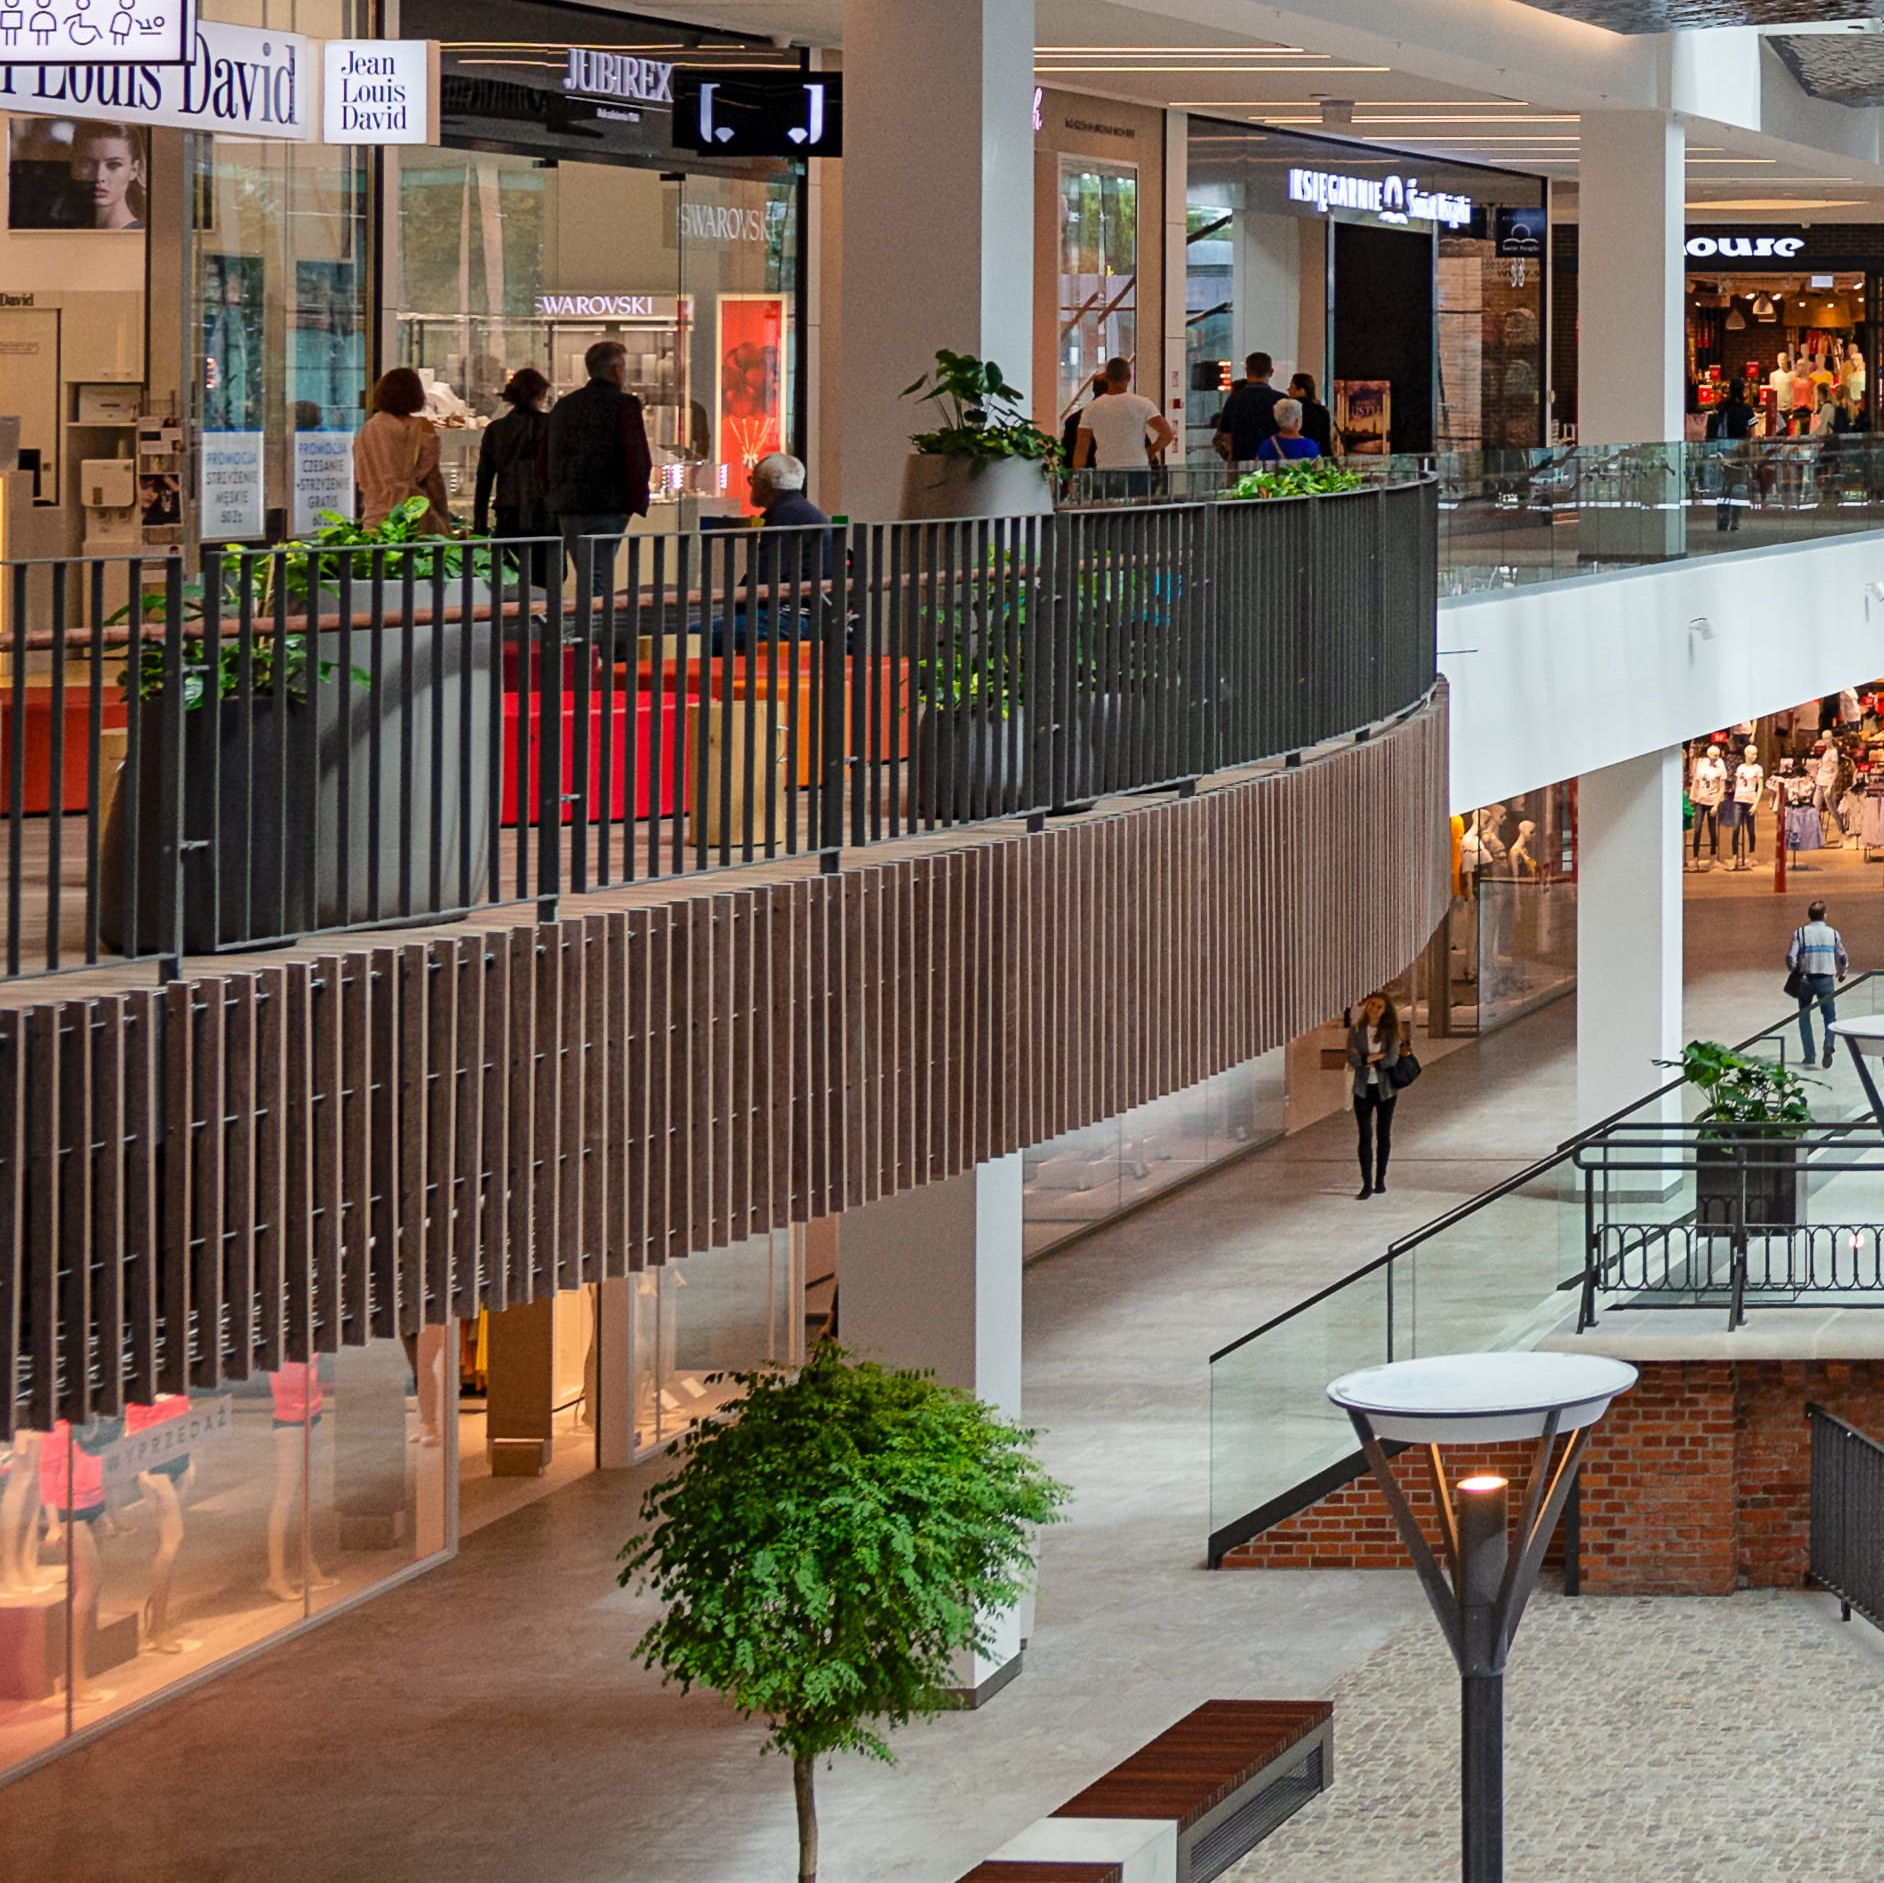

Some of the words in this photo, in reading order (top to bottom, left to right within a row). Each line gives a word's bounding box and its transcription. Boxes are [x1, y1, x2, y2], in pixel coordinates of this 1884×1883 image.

[341, 50, 395, 75] Jean
[178, 32, 298, 125] David
[563, 48, 674, 103] JUBIREX
[342, 78, 406, 103] Louis
[341, 106, 408, 130] David
[1288, 168, 1383, 212] KSIĘGARNIE
[1685, 236, 1806, 258] ouse
